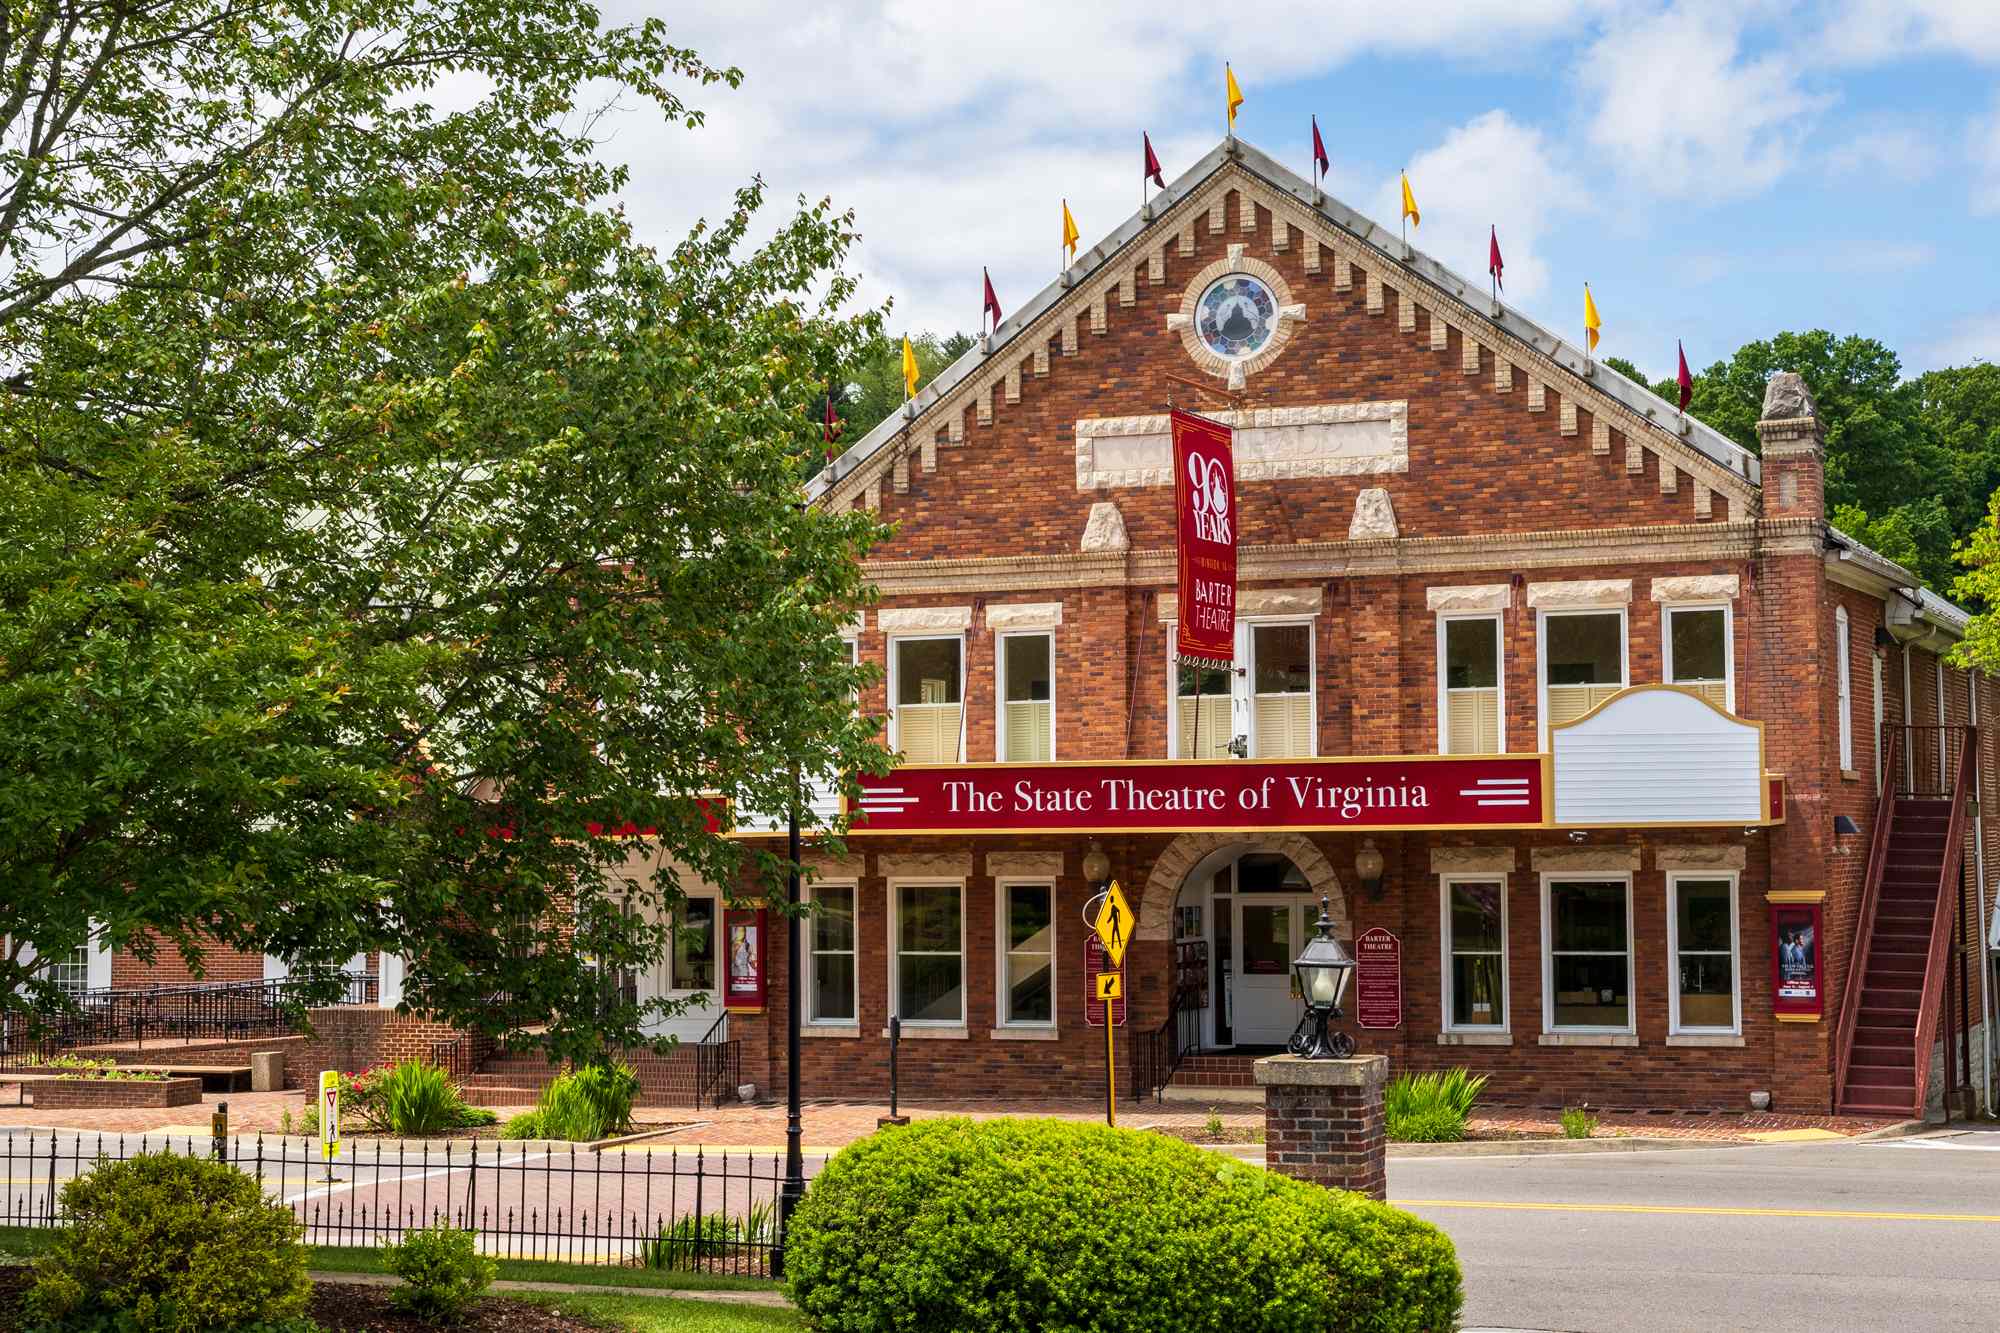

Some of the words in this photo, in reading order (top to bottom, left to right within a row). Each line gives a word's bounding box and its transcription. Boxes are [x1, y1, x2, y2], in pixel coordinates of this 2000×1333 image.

[1188, 451, 1229, 519] 90
[1193, 509, 1232, 546] YEARS
[1195, 578, 1232, 606] BARTER
[1195, 604, 1232, 633] THEATRE
[942, 781, 1003, 812] The
[1014, 780, 1092, 812] State
[1101, 779, 1225, 811] Theatre
[1238, 776, 1274, 810] of
[1286, 776, 1429, 819] Virginia
